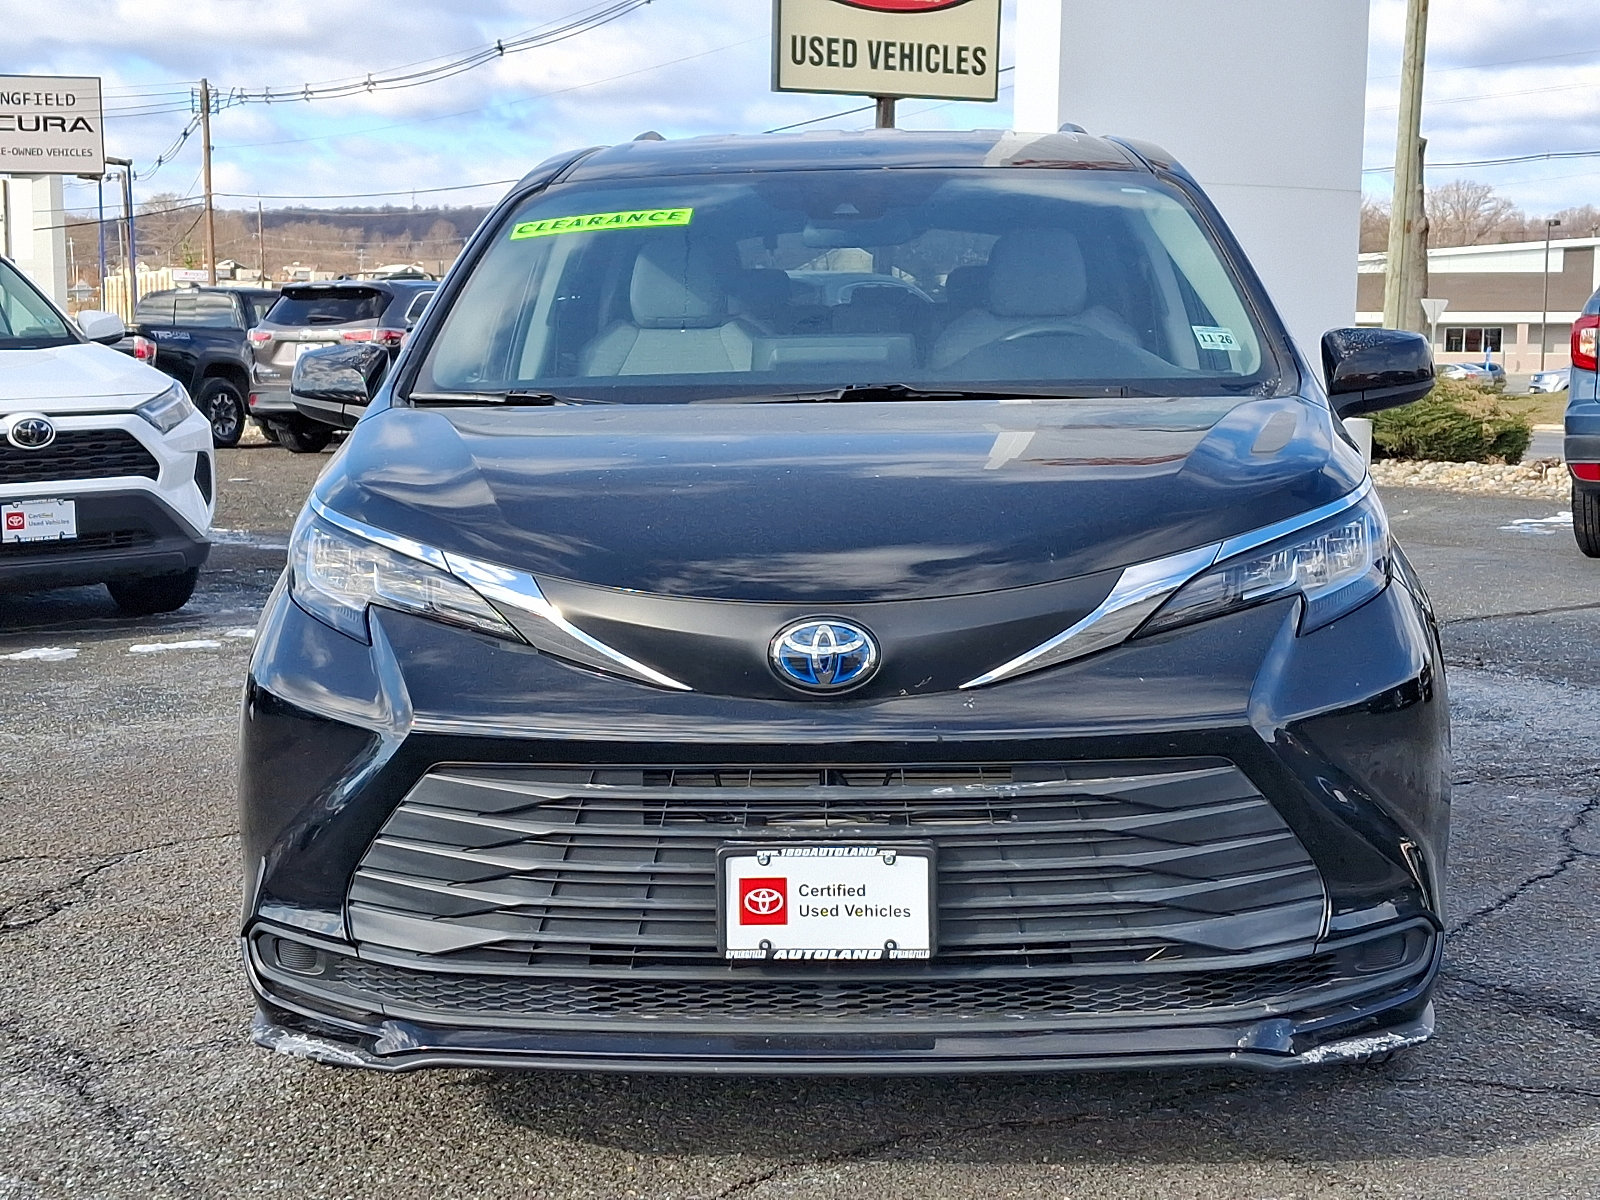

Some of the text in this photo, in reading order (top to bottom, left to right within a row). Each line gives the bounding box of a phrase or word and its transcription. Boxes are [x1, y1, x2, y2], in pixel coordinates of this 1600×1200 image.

[791, 34, 987, 76] USED VEHICLES
[0, 92, 76, 106] NGFIELD
[1, 147, 93, 157] E-OWNED VEHICLES
[516, 210, 687, 234] CLEARANCE
[1200, 333, 1233, 345] 11 26
[799, 883, 866, 897] Certified
[799, 904, 911, 918] Used Vehicles
[773, 949, 883, 960] AUTOLAND
